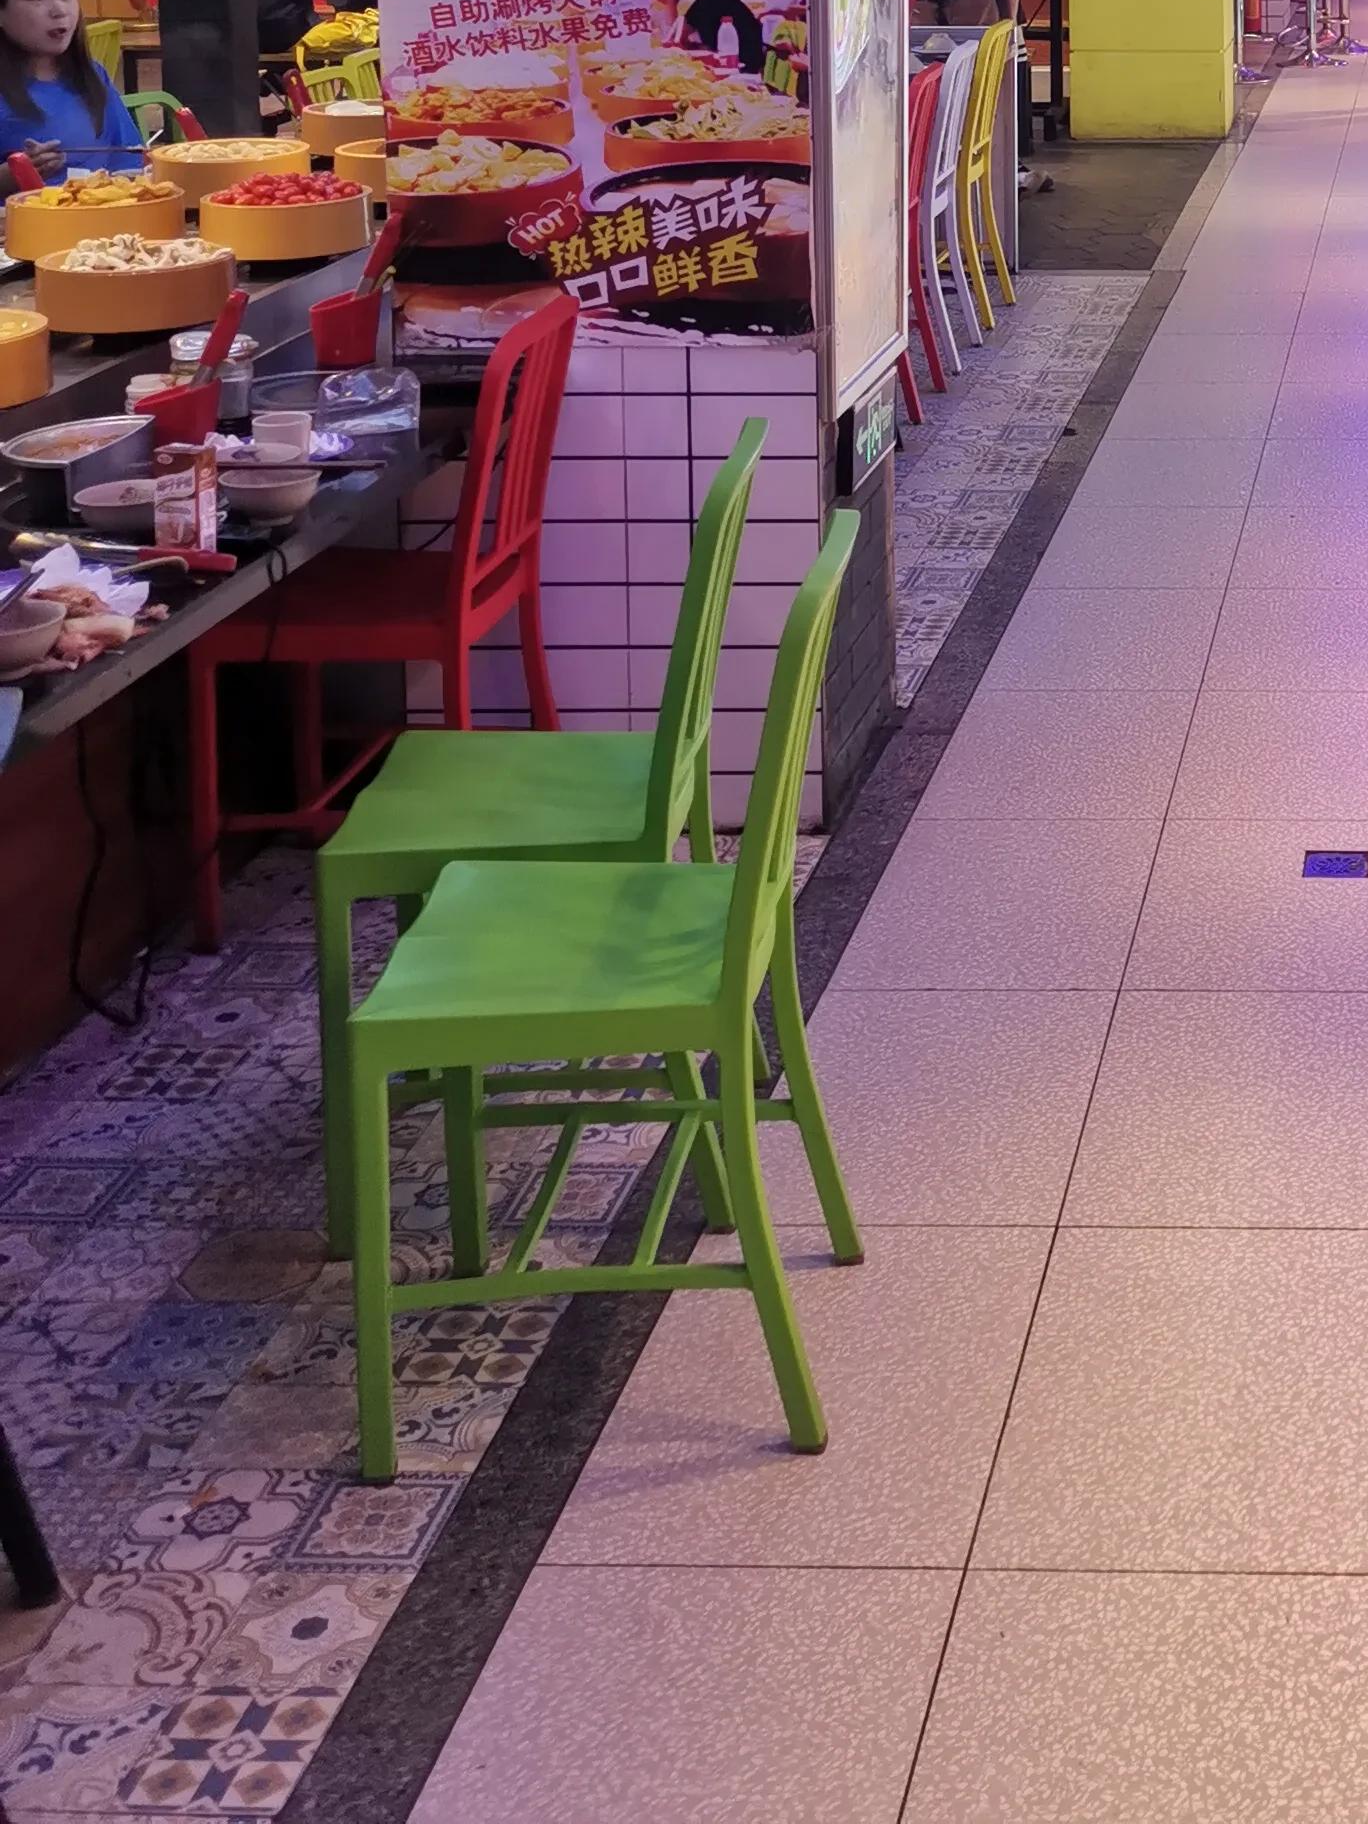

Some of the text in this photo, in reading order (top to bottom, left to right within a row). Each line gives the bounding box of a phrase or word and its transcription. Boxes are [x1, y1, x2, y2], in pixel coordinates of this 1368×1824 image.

[402, 7, 654, 68] 酒水饮料水果免费
[517, 207, 567, 244] HOT
[547, 176, 768, 277] 热辣美味
[563, 231, 760, 310] 口口鲜香
